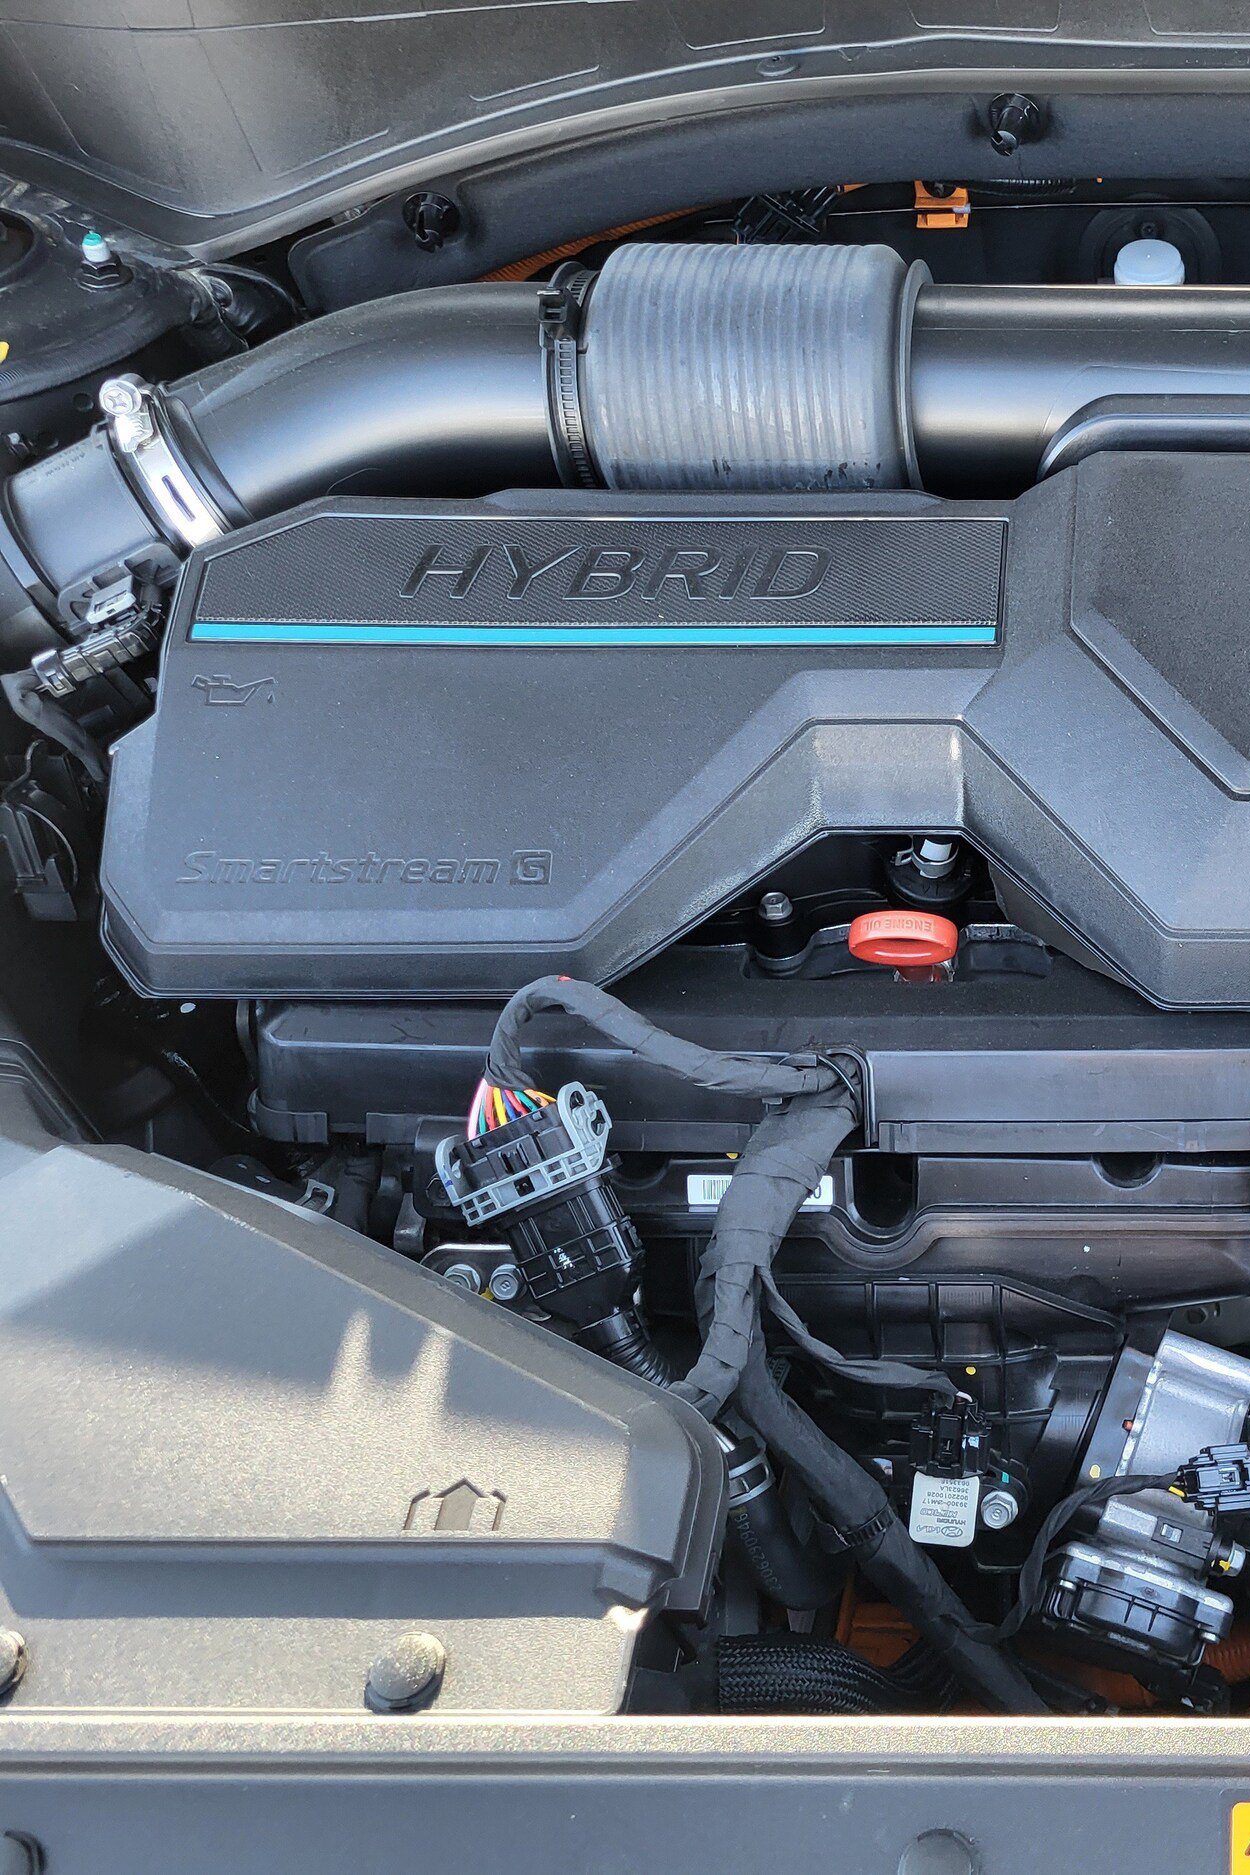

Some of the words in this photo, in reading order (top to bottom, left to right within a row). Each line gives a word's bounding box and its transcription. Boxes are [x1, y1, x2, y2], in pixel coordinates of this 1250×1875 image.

[399, 543, 834, 601] HYBRID
[175, 850, 500, 884] Smartstream
[863, 918, 881, 932] OIL
[884, 918, 932, 932] ENGINE
